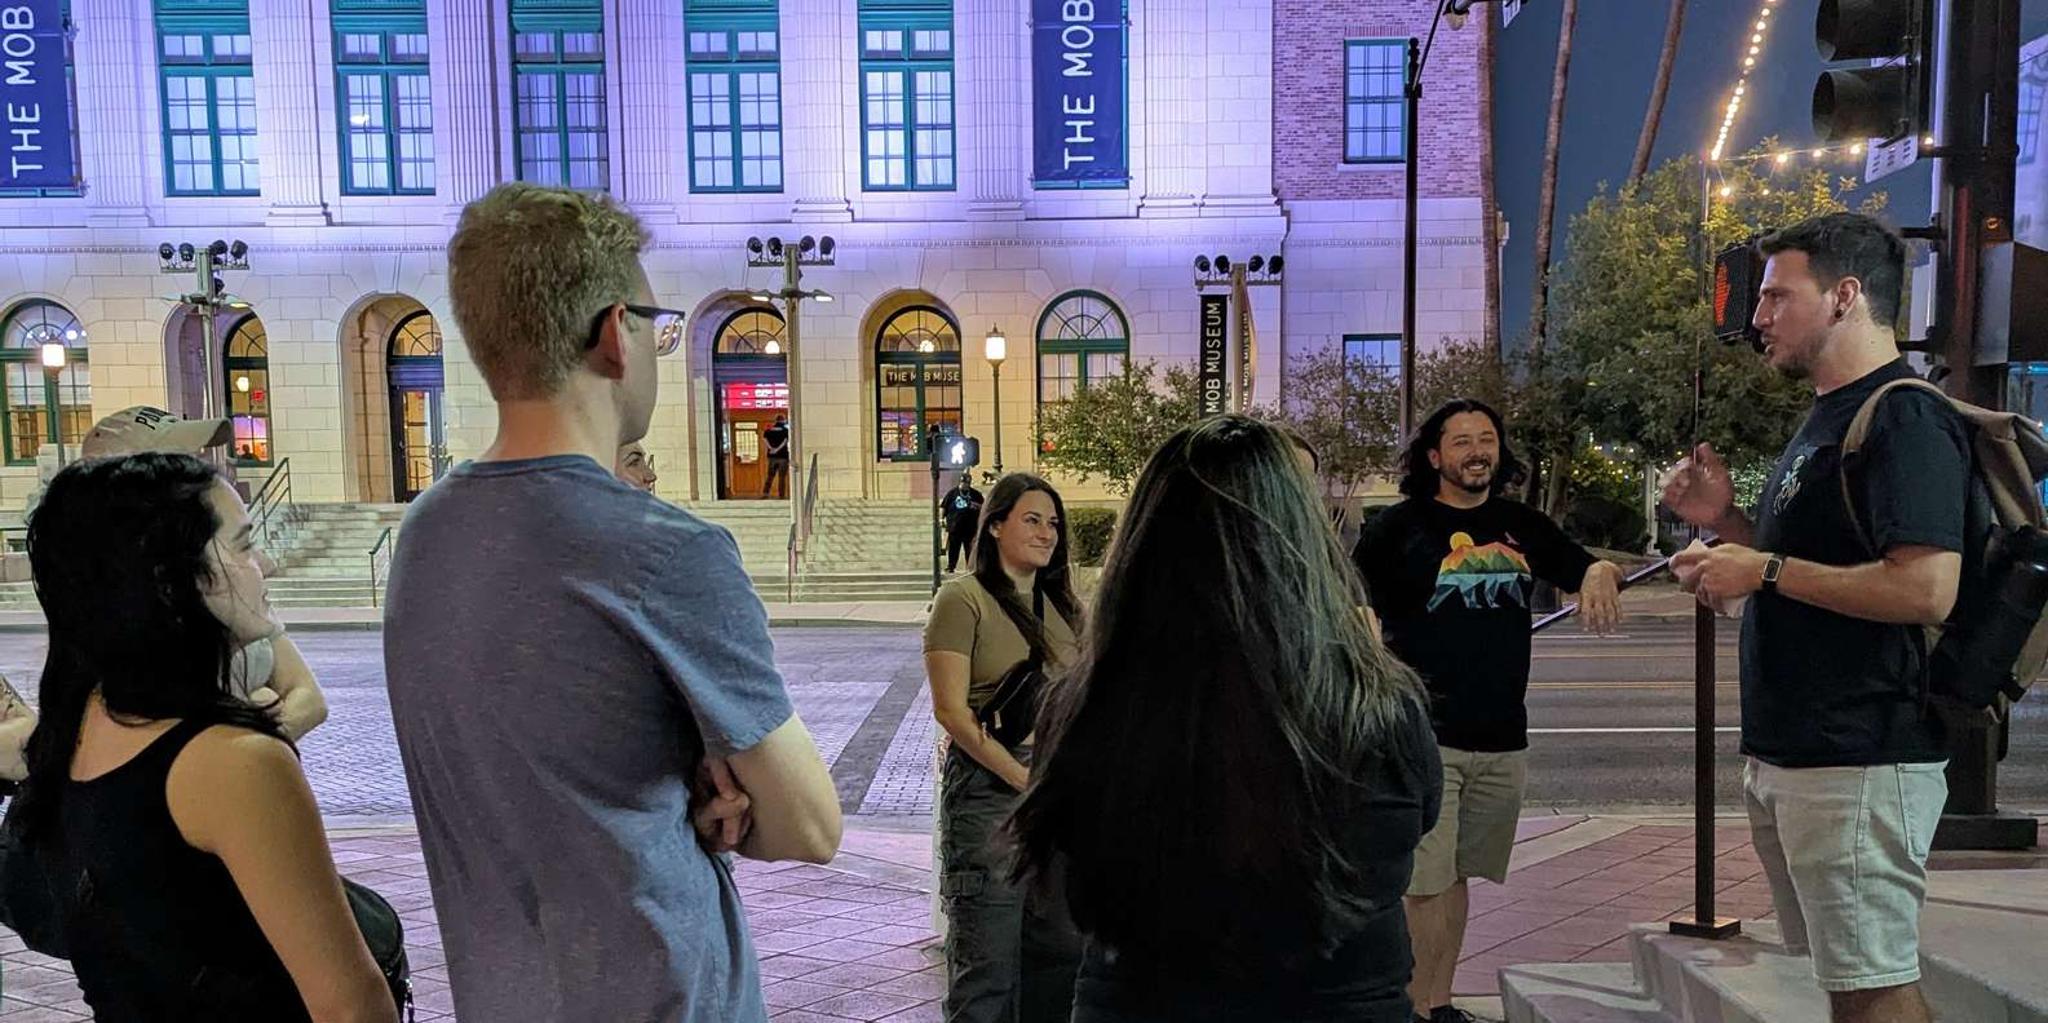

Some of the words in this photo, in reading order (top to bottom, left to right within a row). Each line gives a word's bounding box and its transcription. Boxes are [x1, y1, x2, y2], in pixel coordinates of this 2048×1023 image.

[2, 6, 36, 84] MOB
[1062, 0, 1095, 76] MOB
[8, 103, 43, 179] THE
[1063, 94, 1095, 170] THE
[1205, 302, 1221, 373] MUSEUM
[910, 371, 931, 382] MB
[1205, 378, 1221, 413] MOB
